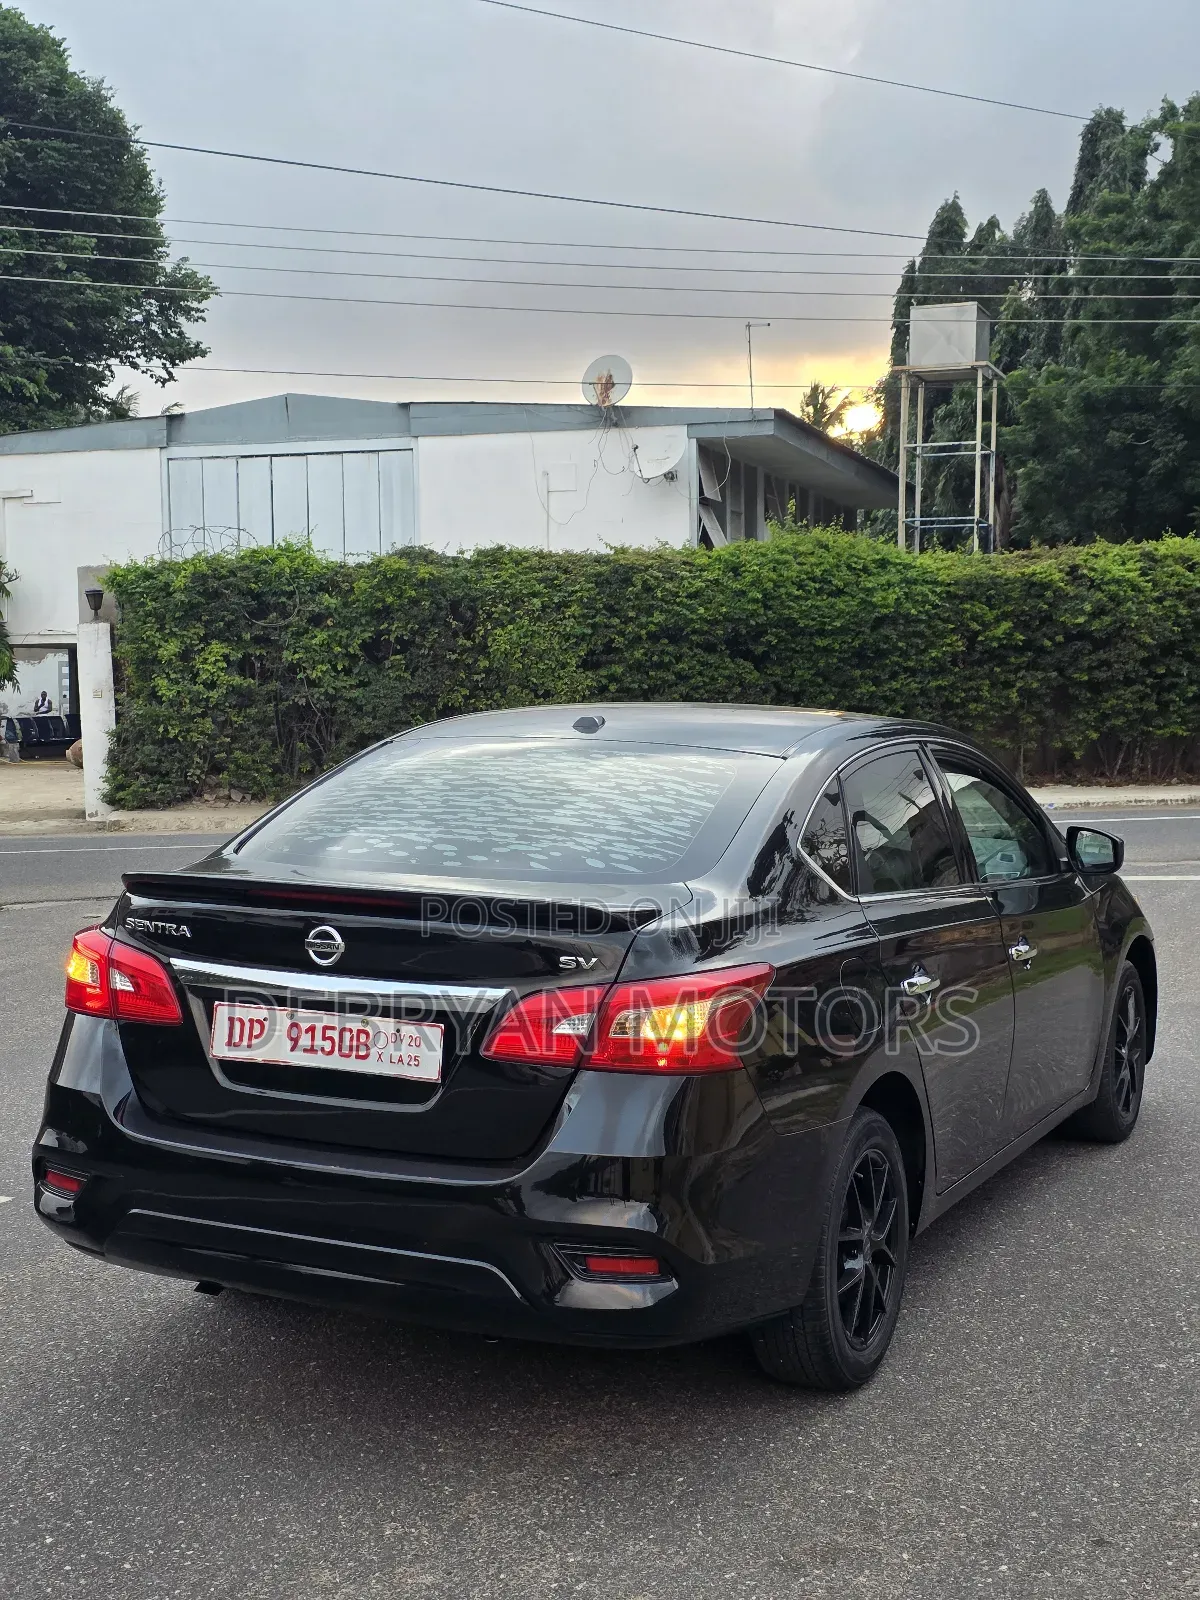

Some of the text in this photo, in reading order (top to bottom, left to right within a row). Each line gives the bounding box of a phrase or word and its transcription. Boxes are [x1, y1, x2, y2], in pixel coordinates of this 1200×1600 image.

[125, 917, 193, 938] SENTRA
[308, 940, 341, 952] NISSAN
[559, 956, 599, 970] SV
[224, 1016, 266, 1049] DP
